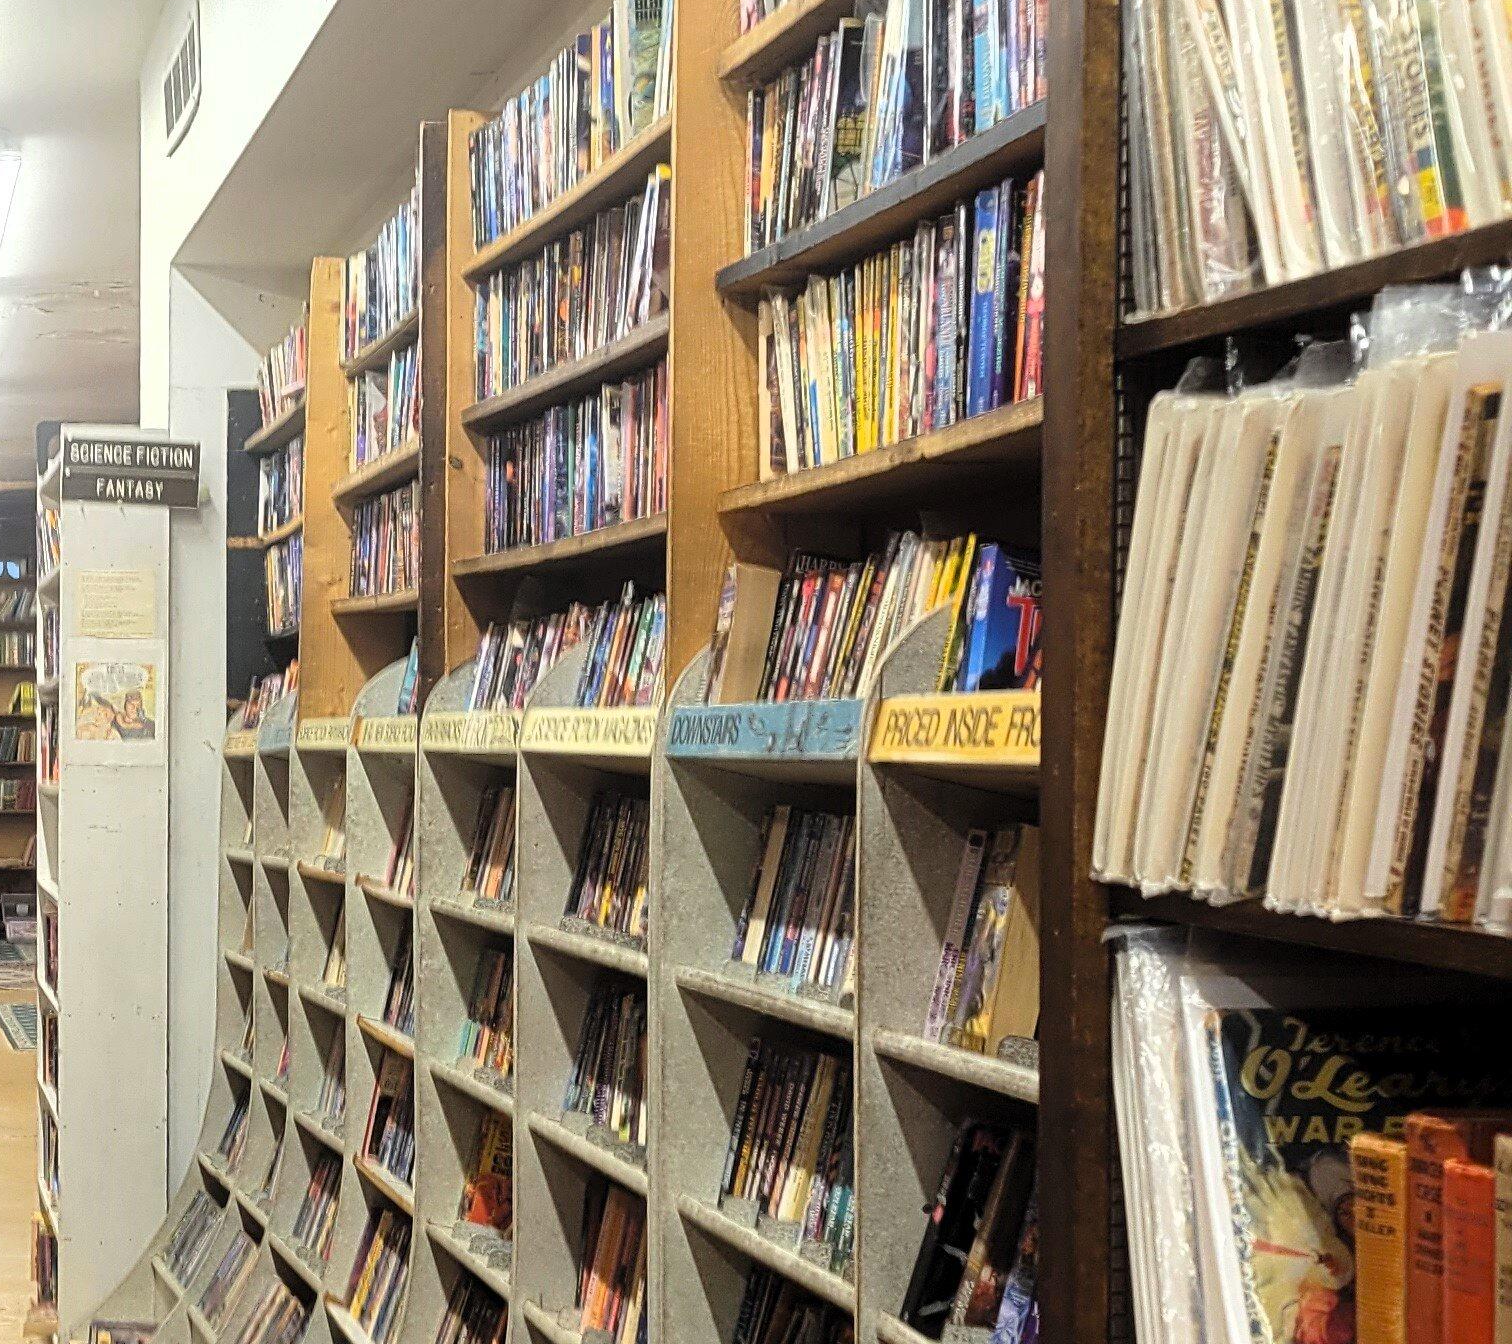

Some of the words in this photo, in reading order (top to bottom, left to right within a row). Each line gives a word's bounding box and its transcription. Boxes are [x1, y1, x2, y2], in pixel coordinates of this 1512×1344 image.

[70, 443, 132, 466] SCIENCE
[136, 445, 193, 469] FICTION
[97, 477, 164, 501] FANTASY
[1423, 564, 1452, 650] PLANET
[1407, 657, 1437, 748] STORIES
[671, 712, 744, 747] DOWNSTAIRS
[882, 706, 942, 748] PRICED
[943, 705, 1004, 748] INSIDE
[1248, 712, 1281, 800] MYSTERIES
